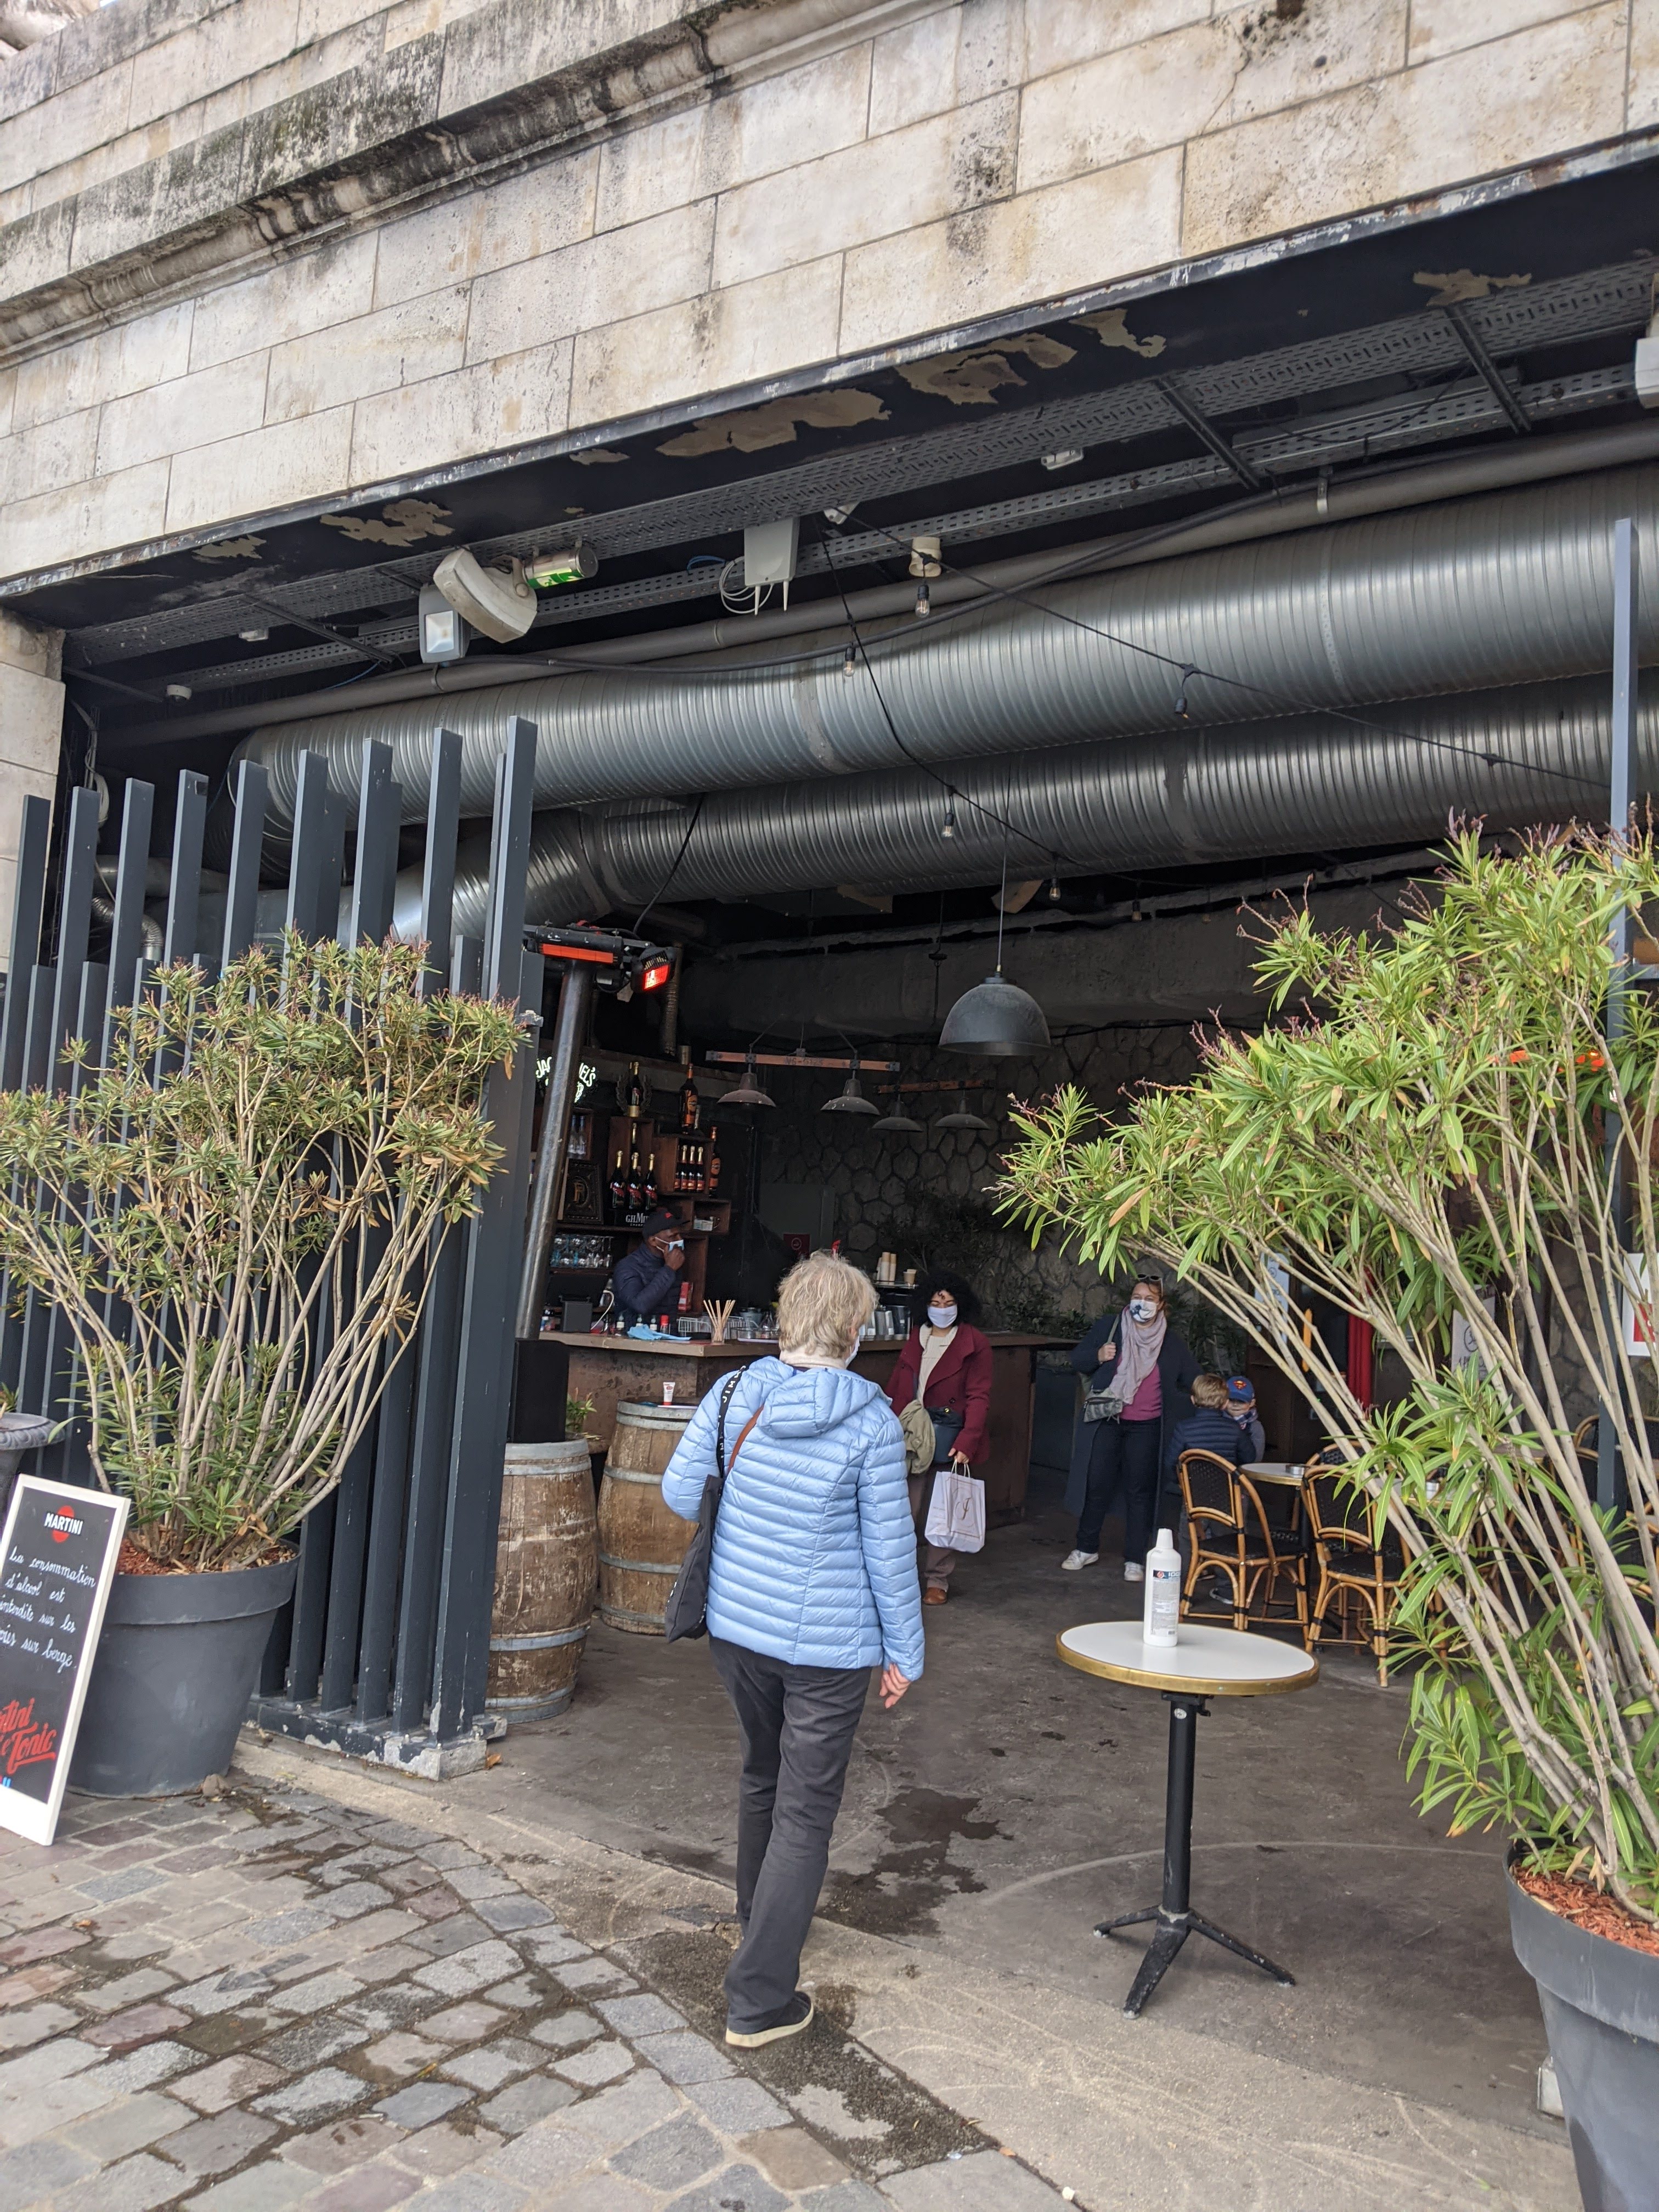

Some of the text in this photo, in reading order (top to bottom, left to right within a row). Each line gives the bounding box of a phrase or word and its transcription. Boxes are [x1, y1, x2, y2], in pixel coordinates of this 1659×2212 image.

[44, 1512, 83, 1535] MARTINI
[9, 1546, 96, 1588] La consommation
[5, 1572, 65, 1603] d'alcool est
[38, 1613, 55, 1627] sur
[60, 1613, 76, 1633] les
[21, 1638, 40, 1654] sur
[6, 1721, 57, 1775] Tonic
